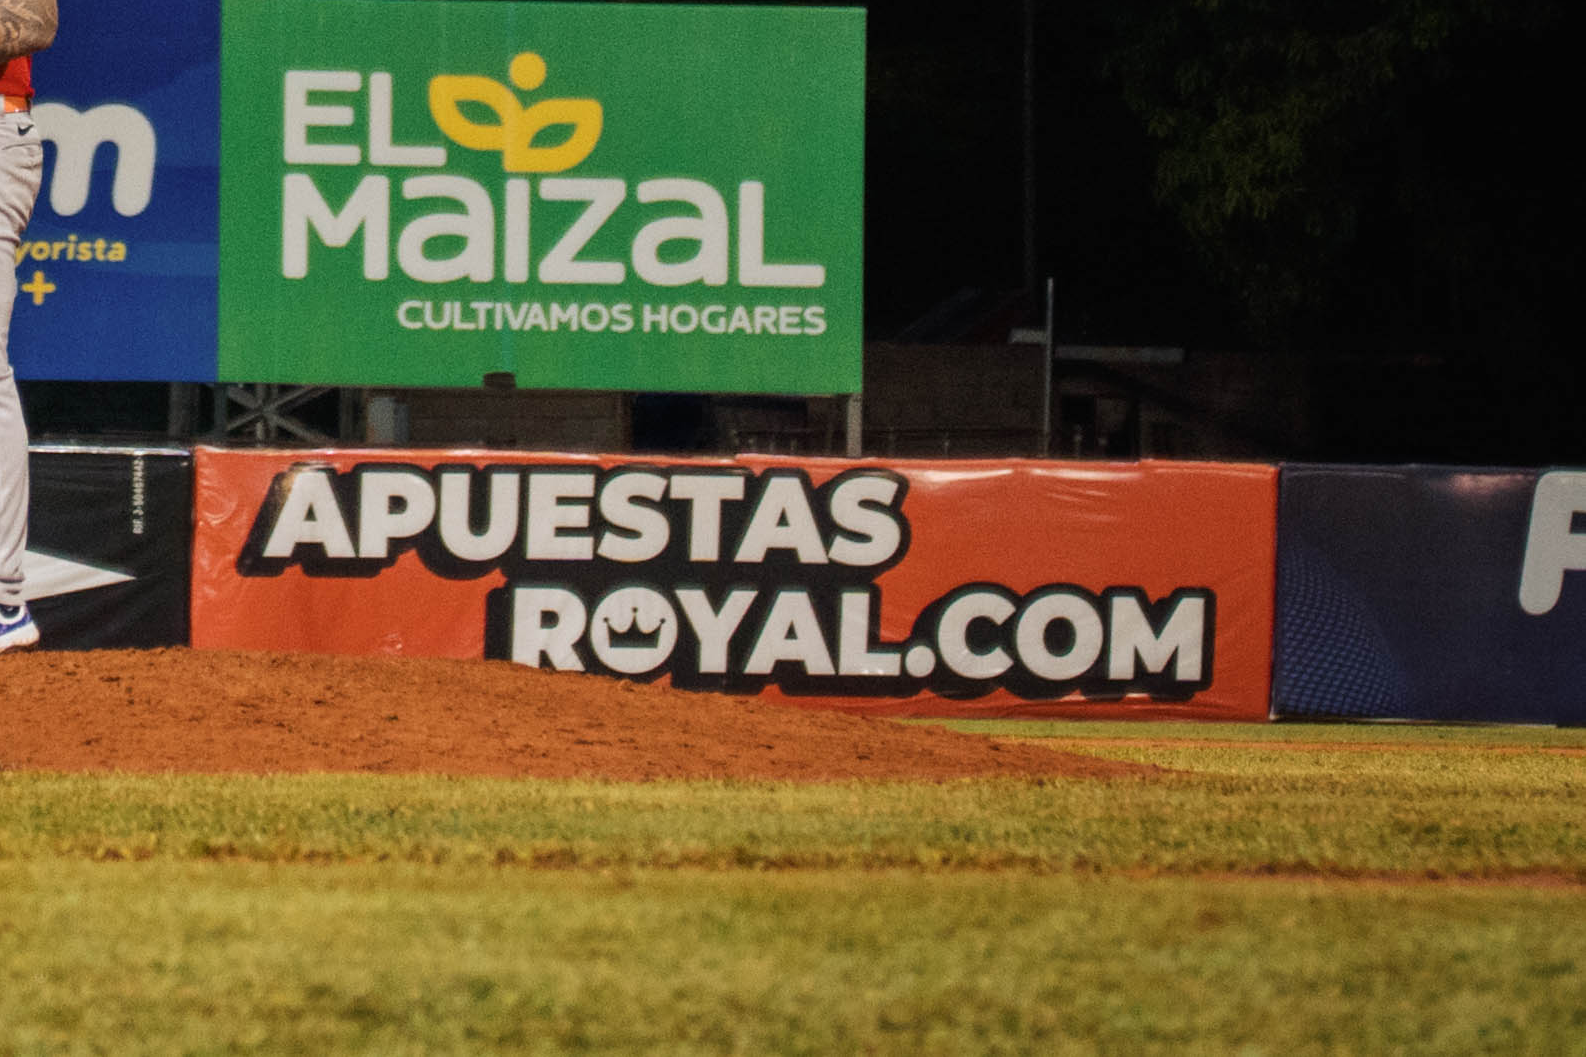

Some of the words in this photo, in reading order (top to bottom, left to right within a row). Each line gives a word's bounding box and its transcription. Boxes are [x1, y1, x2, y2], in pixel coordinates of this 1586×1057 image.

[282, 69, 448, 168] EL
[396, 299, 634, 333] CULTIVAMOS
[642, 303, 827, 335] HOGARES
[262, 470, 904, 567] APUESTAS
[510, 584, 1207, 684] ROYAL.COM
